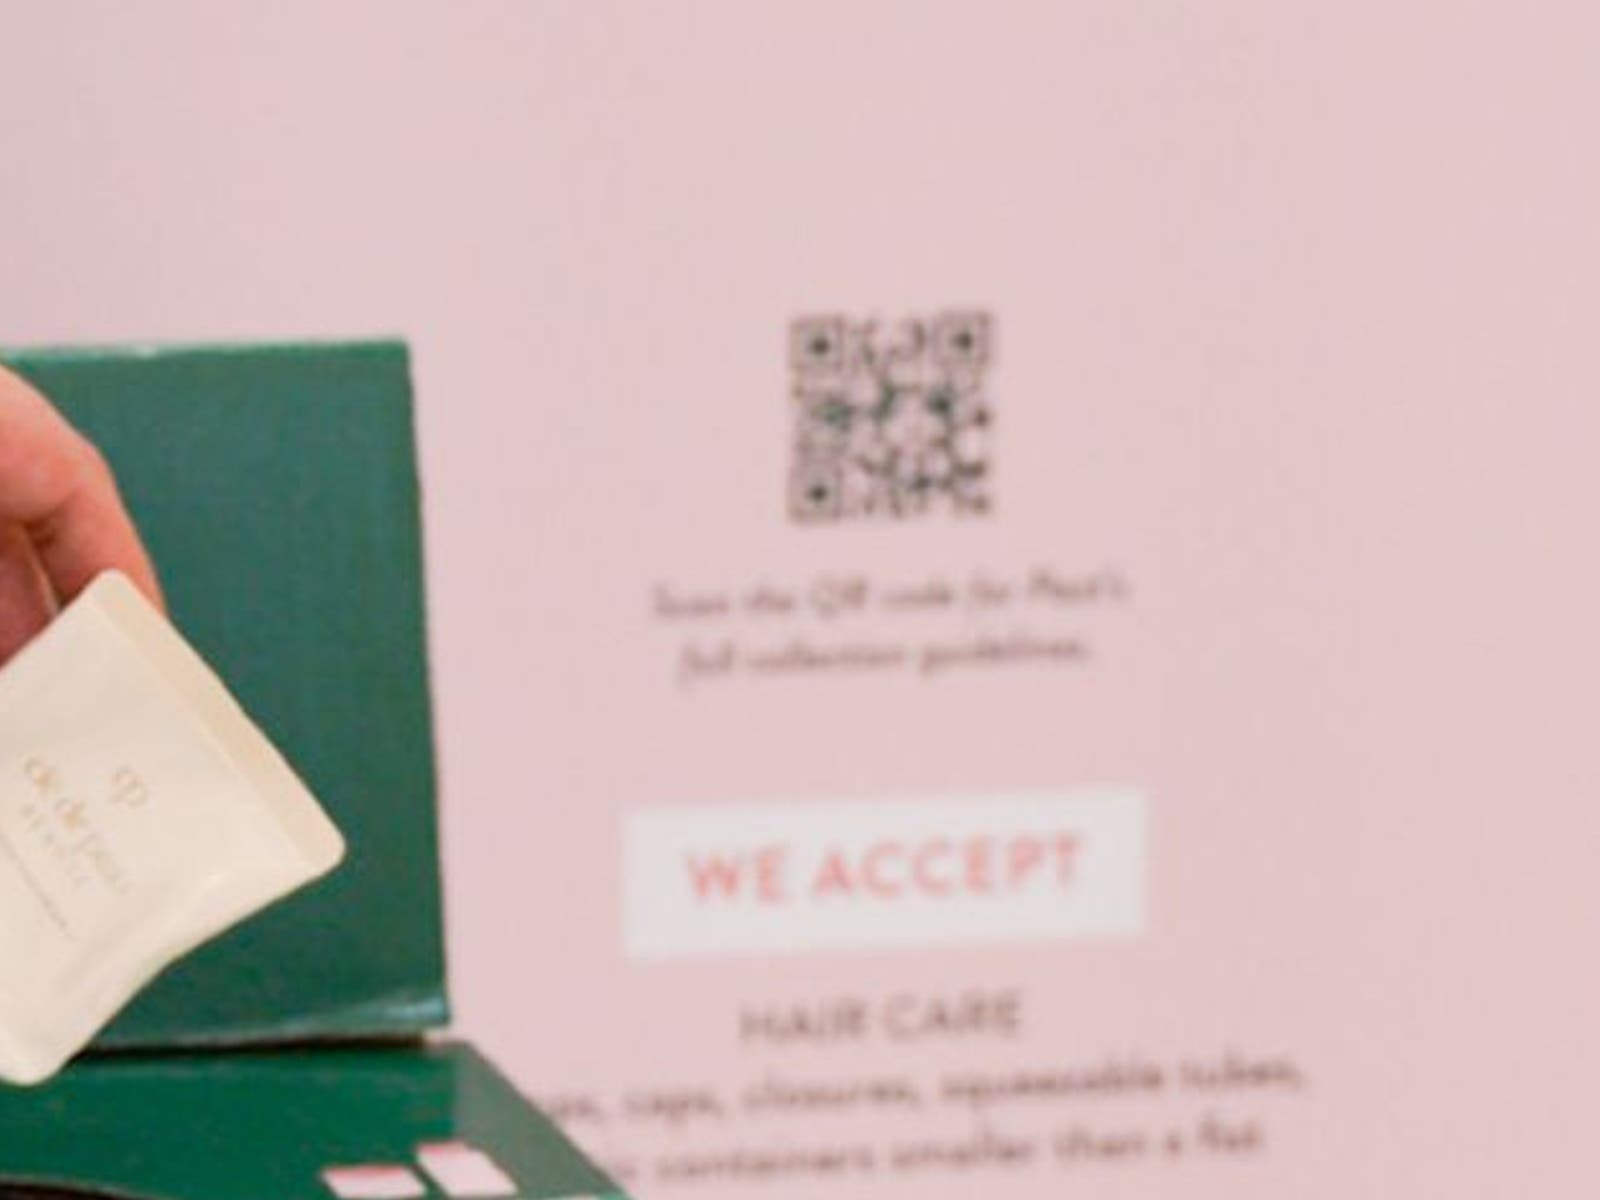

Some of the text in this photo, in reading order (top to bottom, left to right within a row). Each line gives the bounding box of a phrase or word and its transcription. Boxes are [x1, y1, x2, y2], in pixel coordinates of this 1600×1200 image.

[684, 831, 1086, 905] WE ACCEPT
[740, 990, 1024, 1043] HAIR CARE
[1054, 1122, 1147, 1162] than
